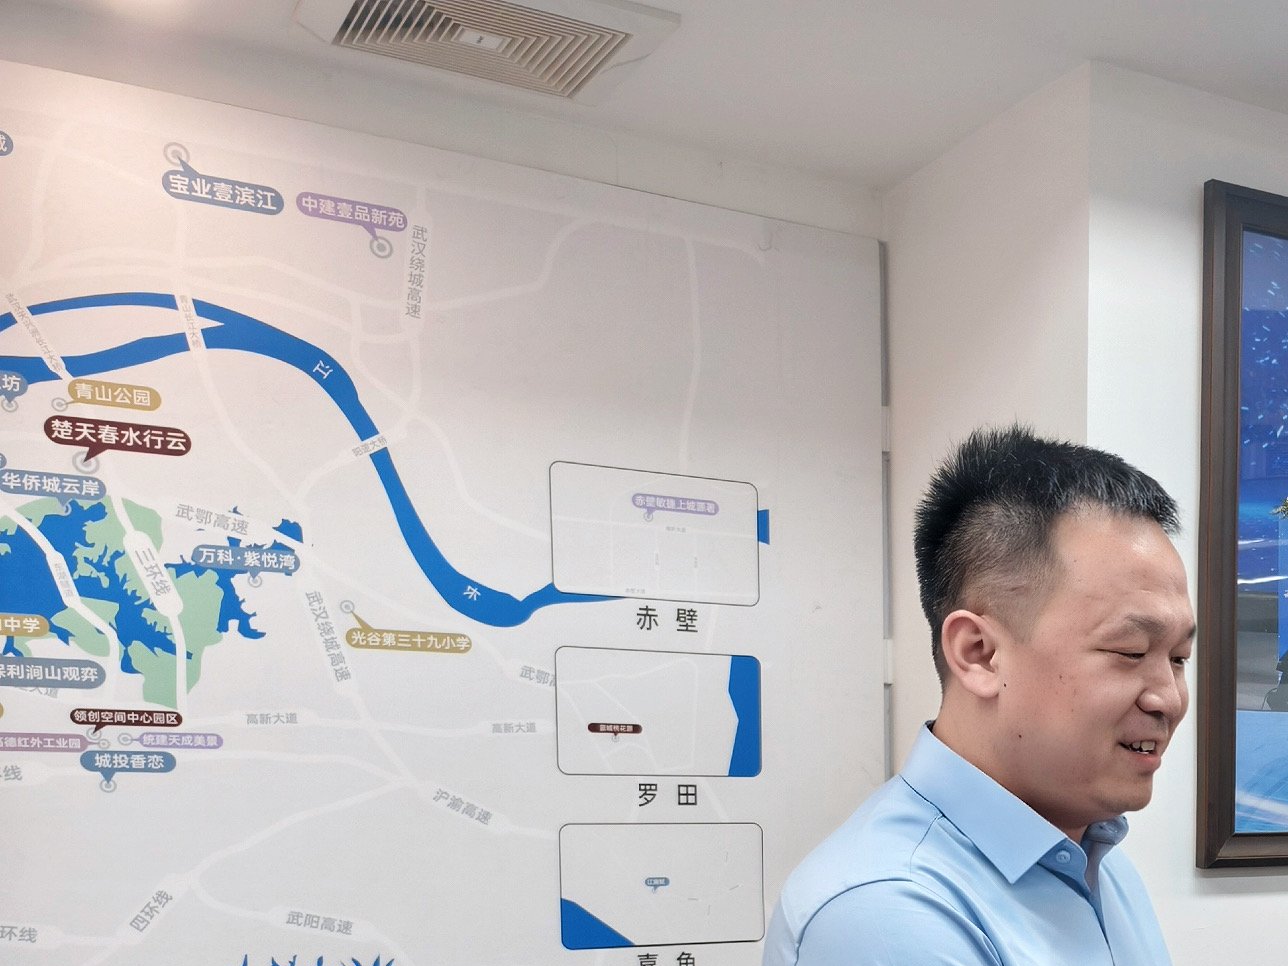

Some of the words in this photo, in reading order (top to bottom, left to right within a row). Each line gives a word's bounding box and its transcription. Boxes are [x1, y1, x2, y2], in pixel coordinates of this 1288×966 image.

[169, 173, 277, 211] 宝业壹滨江
[301, 195, 405, 228] 中建壹品新苑
[405, 225, 428, 319] 武汉绕城高速
[0, 373, 21, 392] 坊
[74, 382, 152, 407] 青山公园
[51, 418, 188, 452] 楚天春水行云
[1, 471, 101, 496] 华侨城云岸
[175, 502, 249, 536] 武鄂高速
[0, 617, 41, 633] 中学
[636, 605, 699, 633] 赤壁
[305, 590, 352, 683] 武汉绕城高速
[351, 631, 471, 650] 光谷第三十九小学
[73, 710, 178, 725] 领创空间中心园区
[246, 712, 298, 725] 高新大道
[0, 764, 23, 781] 线
[94, 753, 165, 770] 城投香恋
[431, 787, 494, 827] 沪渝高速
[638, 783, 698, 807] 罗田
[129, 889, 174, 934] 四环线
[285, 910, 354, 936] 武阳高速
